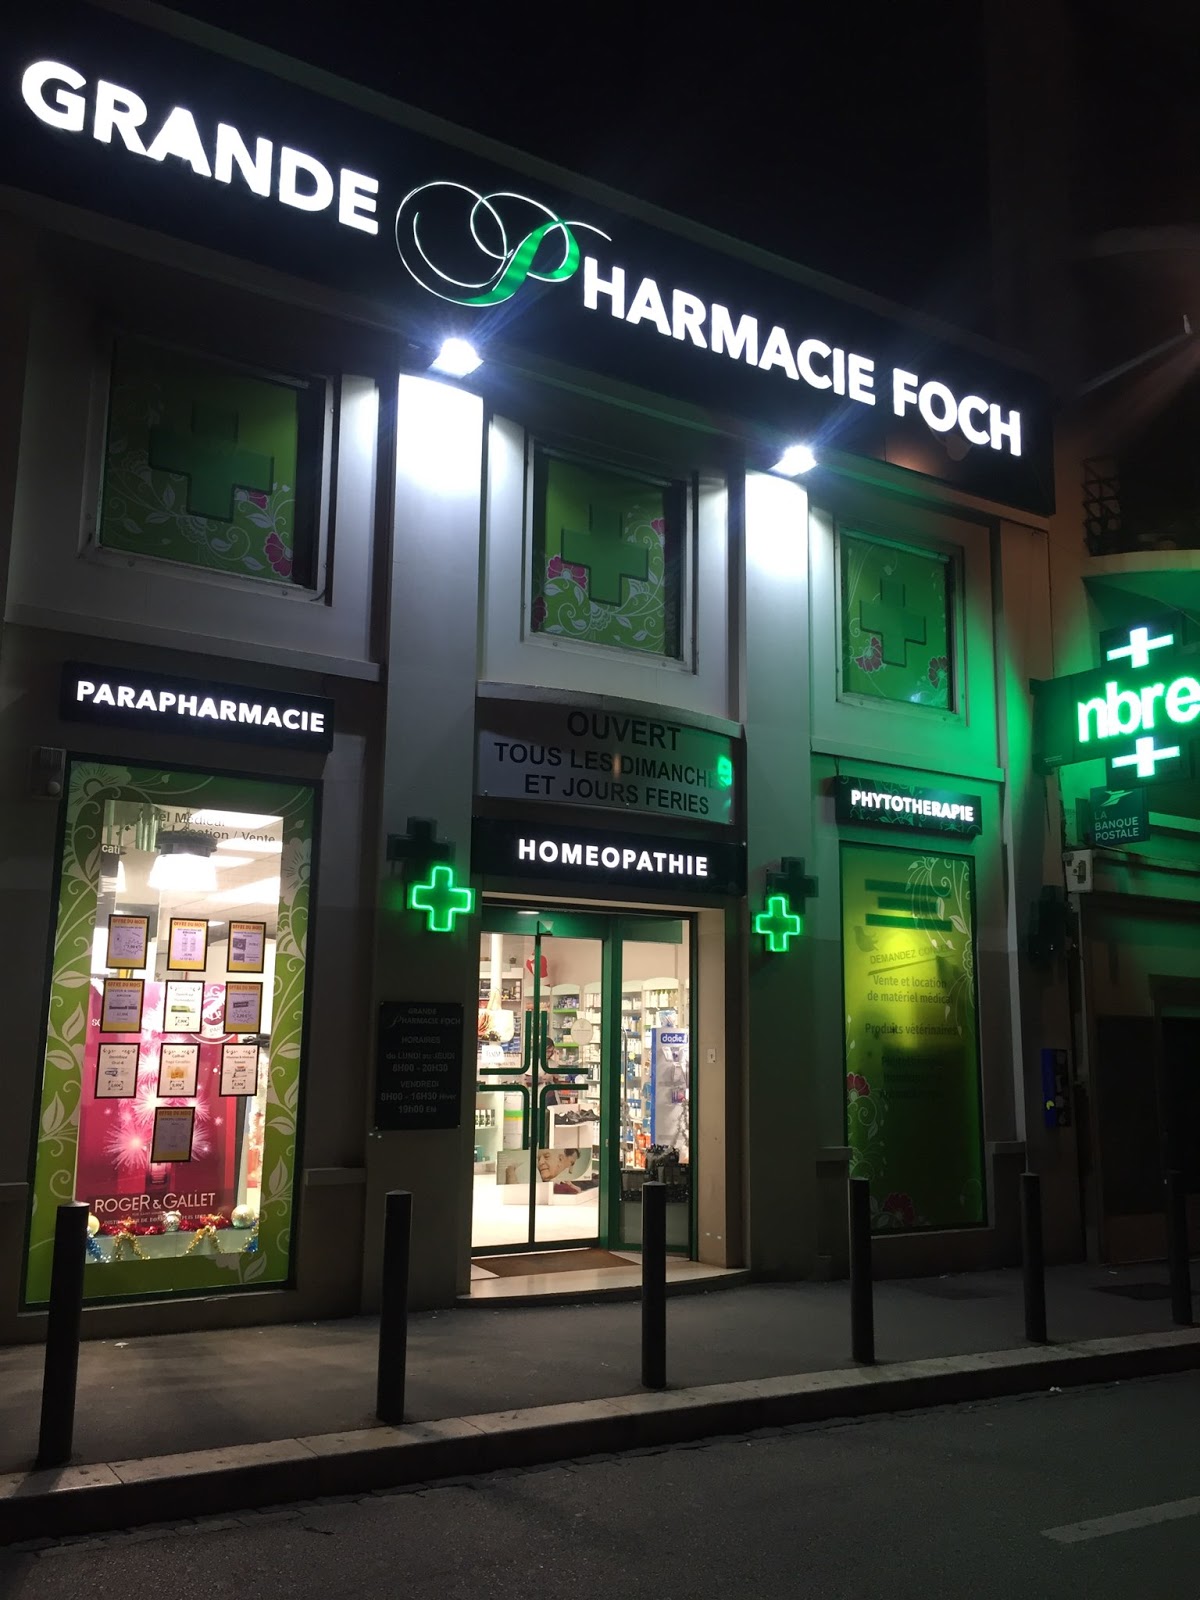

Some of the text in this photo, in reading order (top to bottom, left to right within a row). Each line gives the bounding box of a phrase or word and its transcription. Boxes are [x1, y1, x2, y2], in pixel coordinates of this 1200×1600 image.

[21, 60, 379, 235] GRANDE
[893, 367, 1022, 456] FOCH
[76, 680, 325, 733] PARAPHARMACIE
[567, 711, 681, 750] OUVERT
[494, 742, 732, 788] TOUS LES DIMANCH
[525, 774, 710, 815] ET JOURS FERIES
[851, 789, 974, 822] PHYTOTHERAPIE
[1094, 809, 1108, 820] LA
[1094, 816, 1139, 832] BANQUE
[1095, 826, 1140, 841] POSTALE
[518, 838, 708, 876] HOMEOPATHIE
[870, 949, 916, 965] DEMANDEZ
[873, 975, 947, 988] Vente et location
[867, 990, 953, 1004] de matériel médical
[408, 1007, 437, 1015] GRANDE
[865, 1022, 903, 1034] Produits
[401, 1036, 440, 1044] HORAIRES
[392, 1063, 414, 1072] 8H00
[422, 1063, 448, 1072] 20H30
[95, 1192, 216, 1214] ROGER & GALLET
